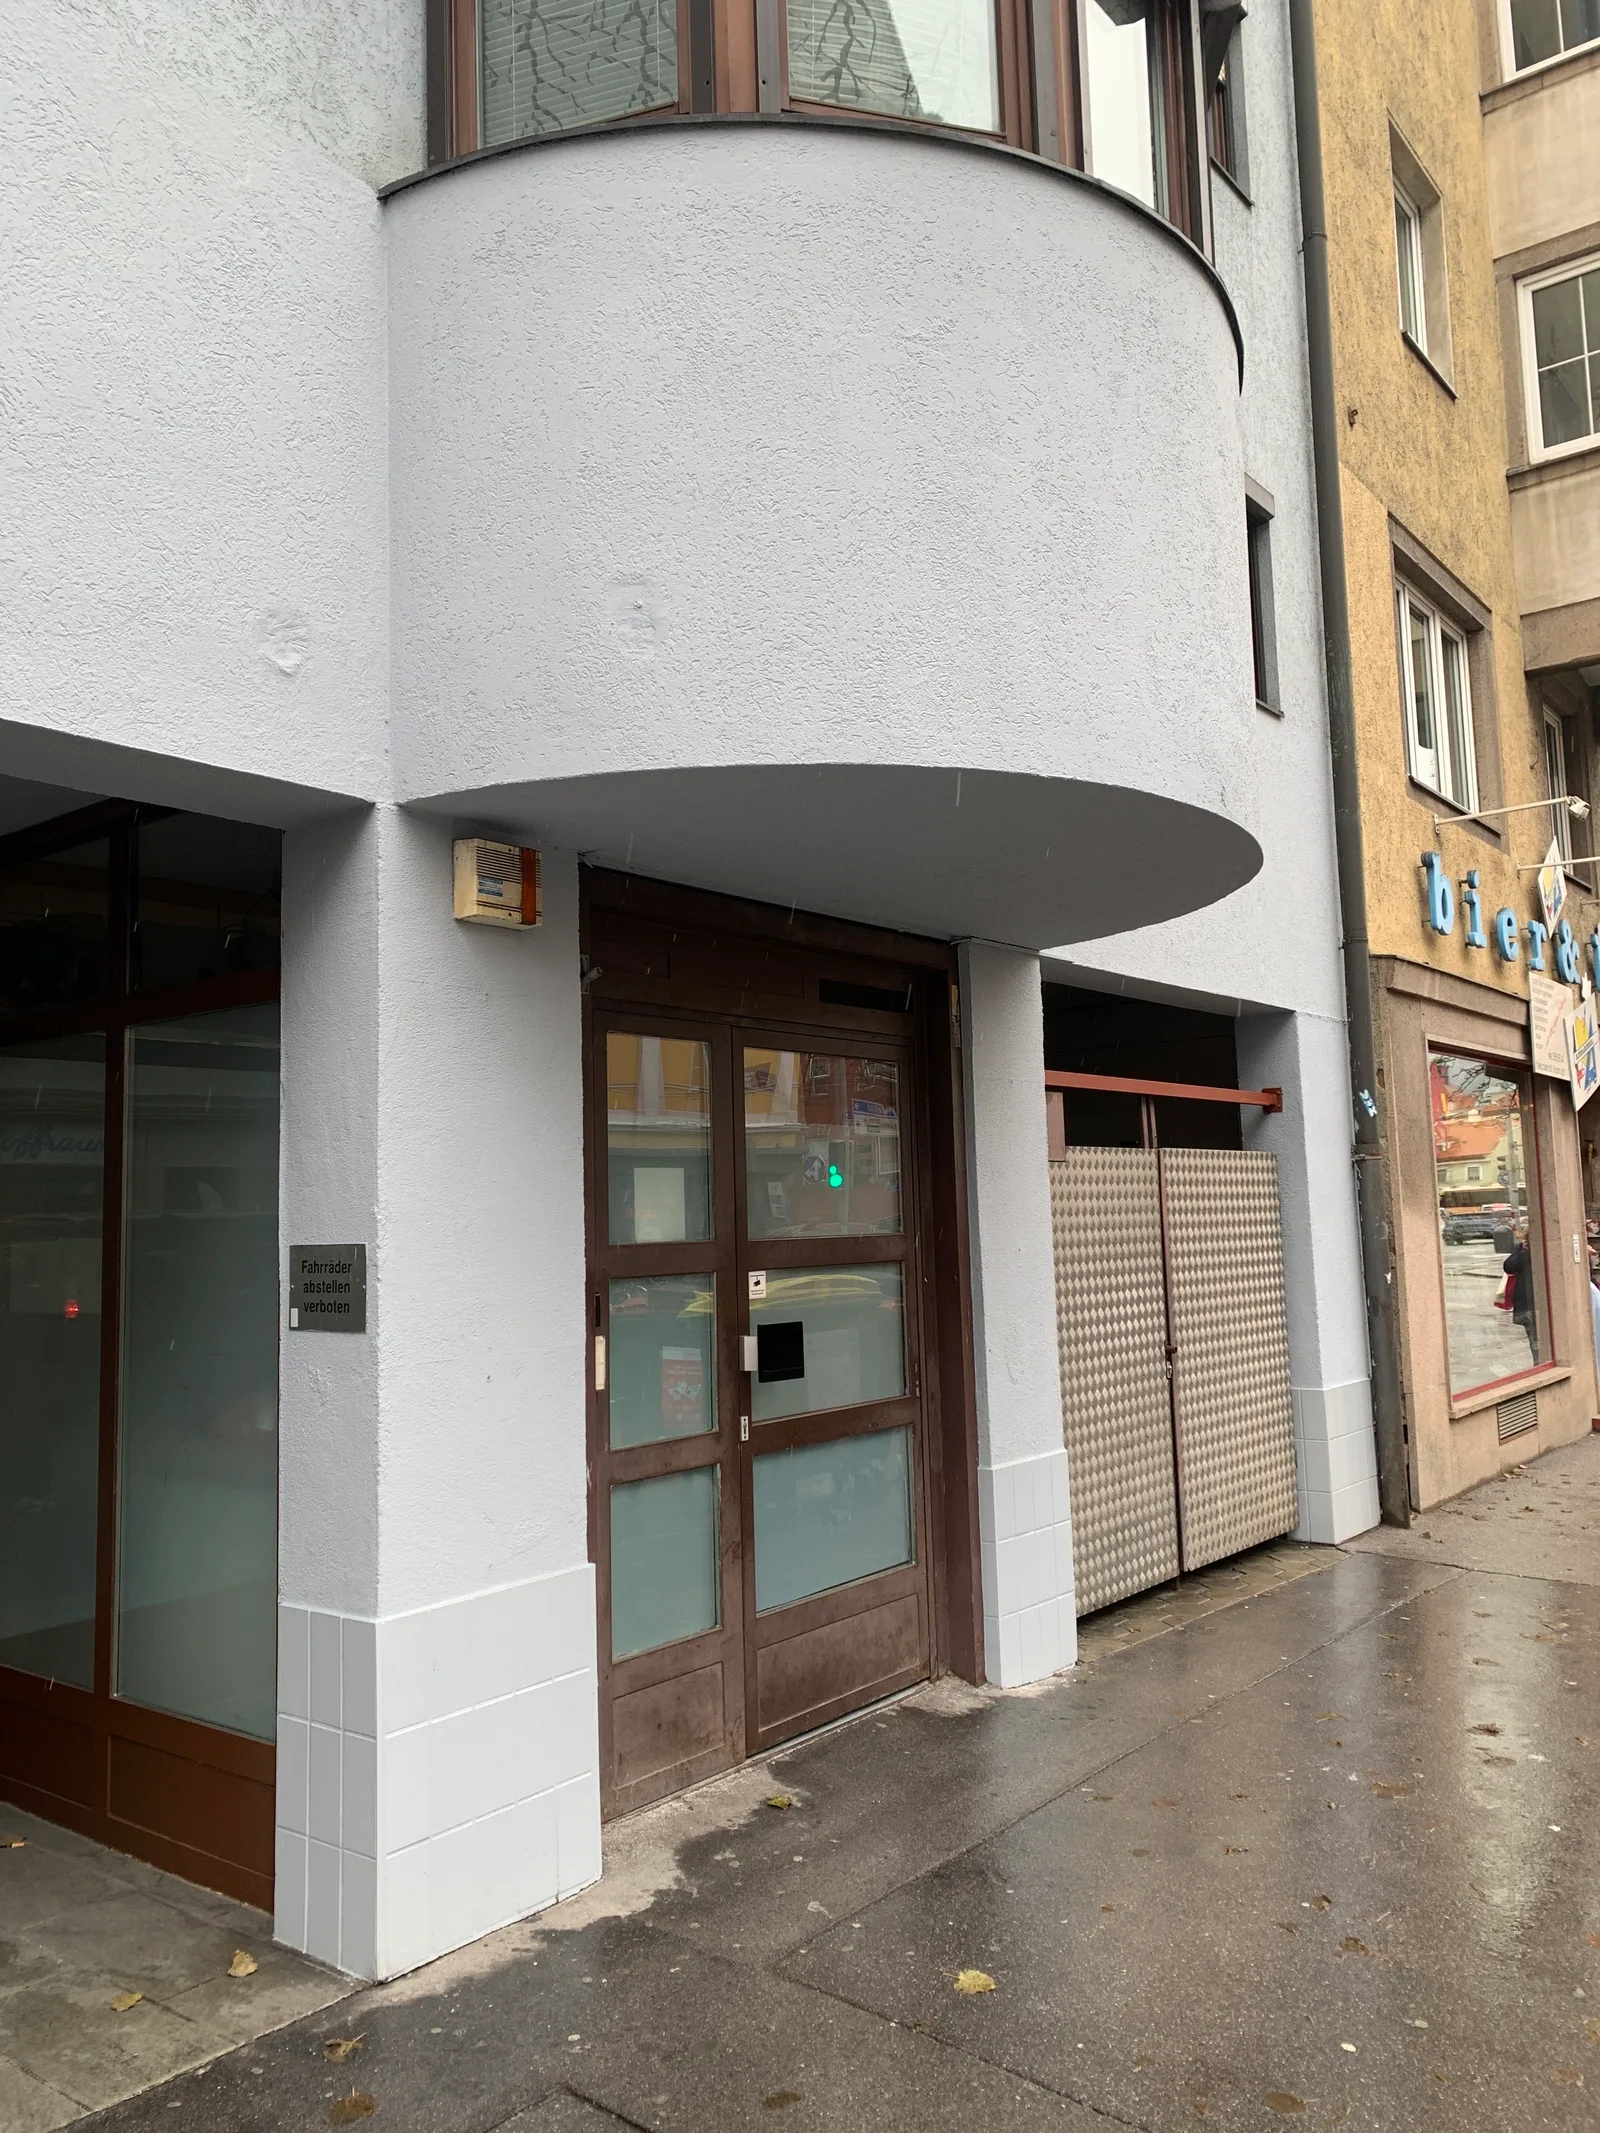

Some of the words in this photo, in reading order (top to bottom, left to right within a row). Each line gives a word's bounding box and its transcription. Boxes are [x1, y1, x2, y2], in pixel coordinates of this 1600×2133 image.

[301, 1259, 352, 1274] Fahrräder
[303, 1280, 351, 1294] abstellen
[303, 1299, 350, 1314] verboten
